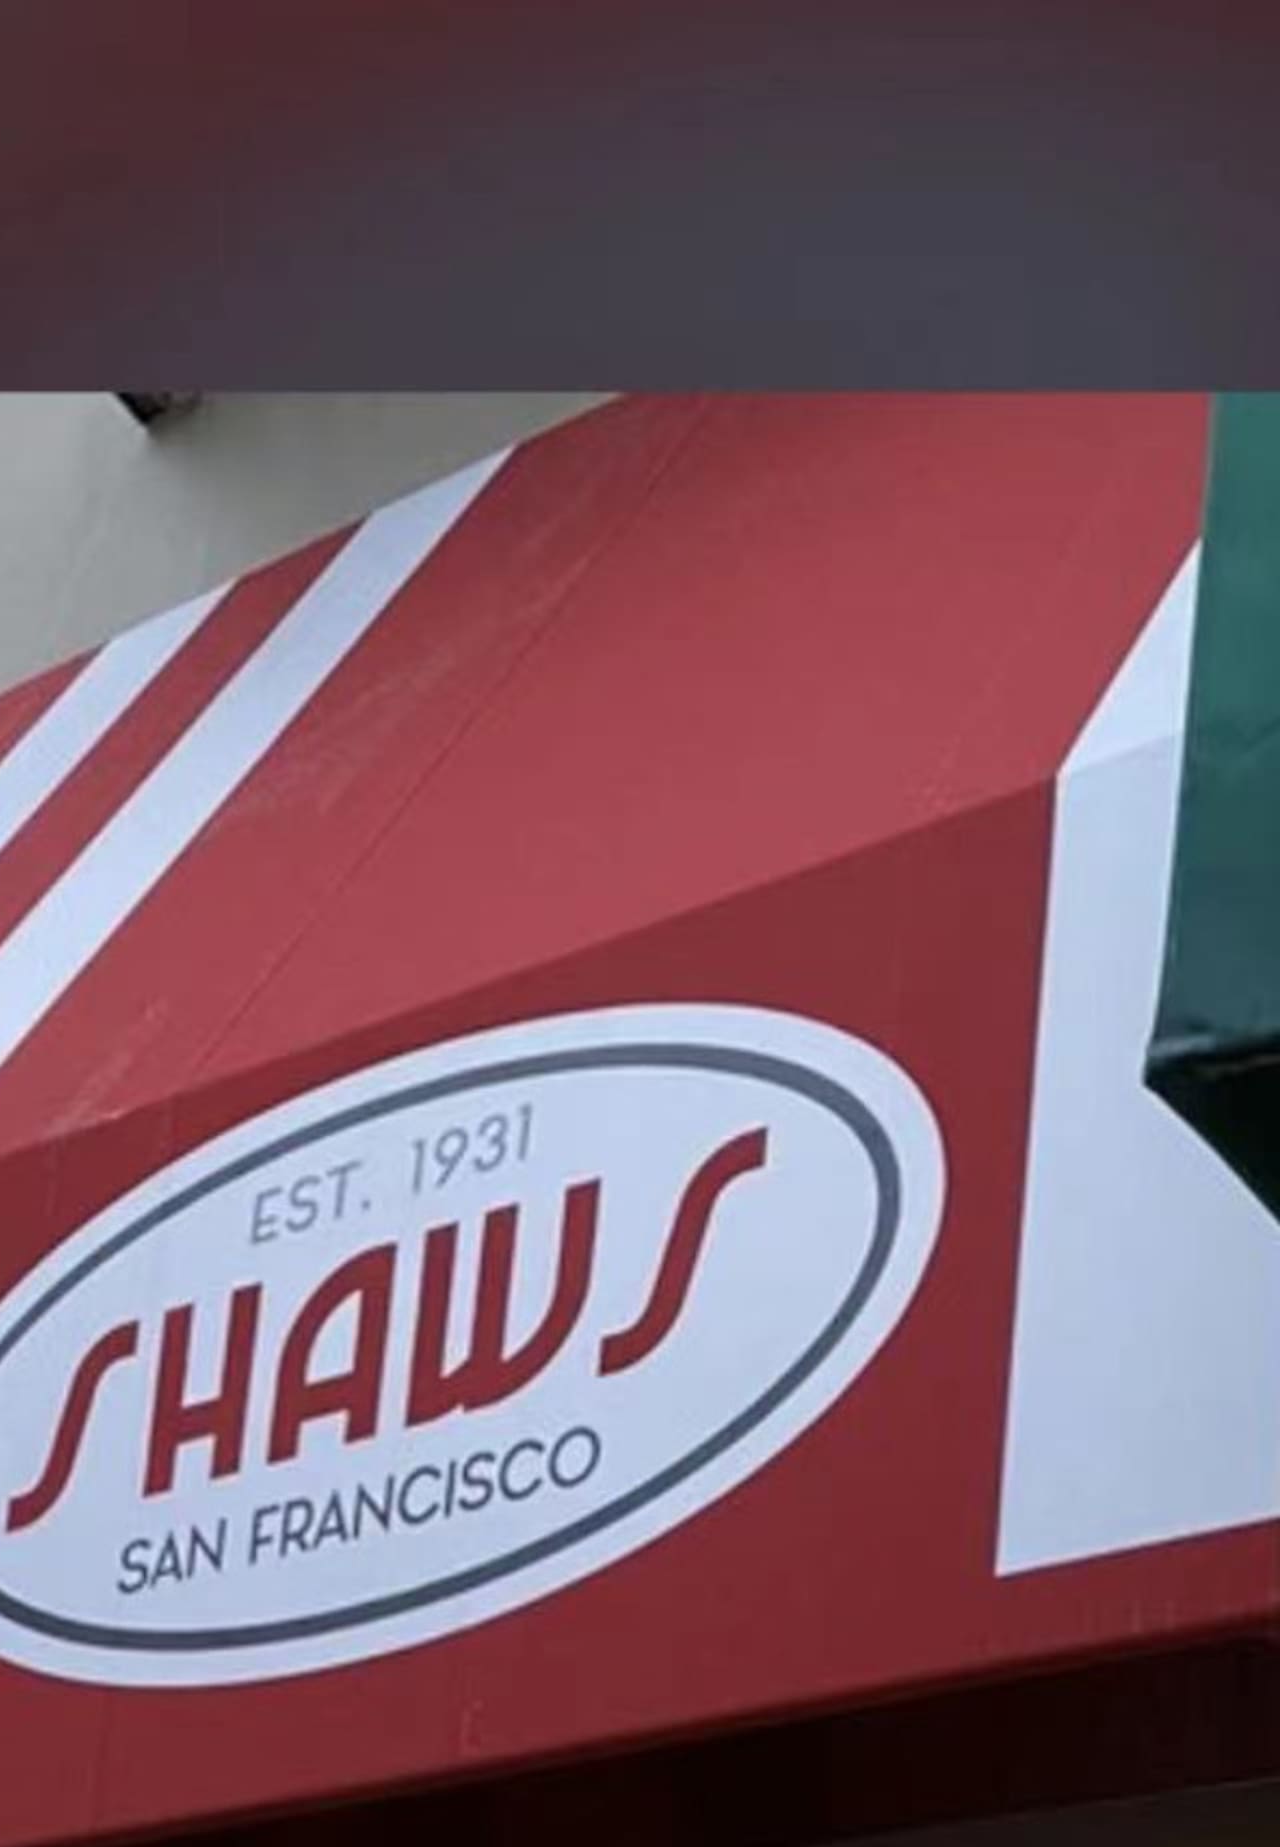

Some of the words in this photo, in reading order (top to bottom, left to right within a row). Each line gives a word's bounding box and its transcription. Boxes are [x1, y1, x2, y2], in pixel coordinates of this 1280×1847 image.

[249, 1164, 371, 1246] EST.
[408, 1104, 535, 1197] 1931
[5, 1126, 769, 1534] SHAWS
[116, 1517, 228, 1594] SAN
[247, 1425, 601, 1567] FRANCISCO
